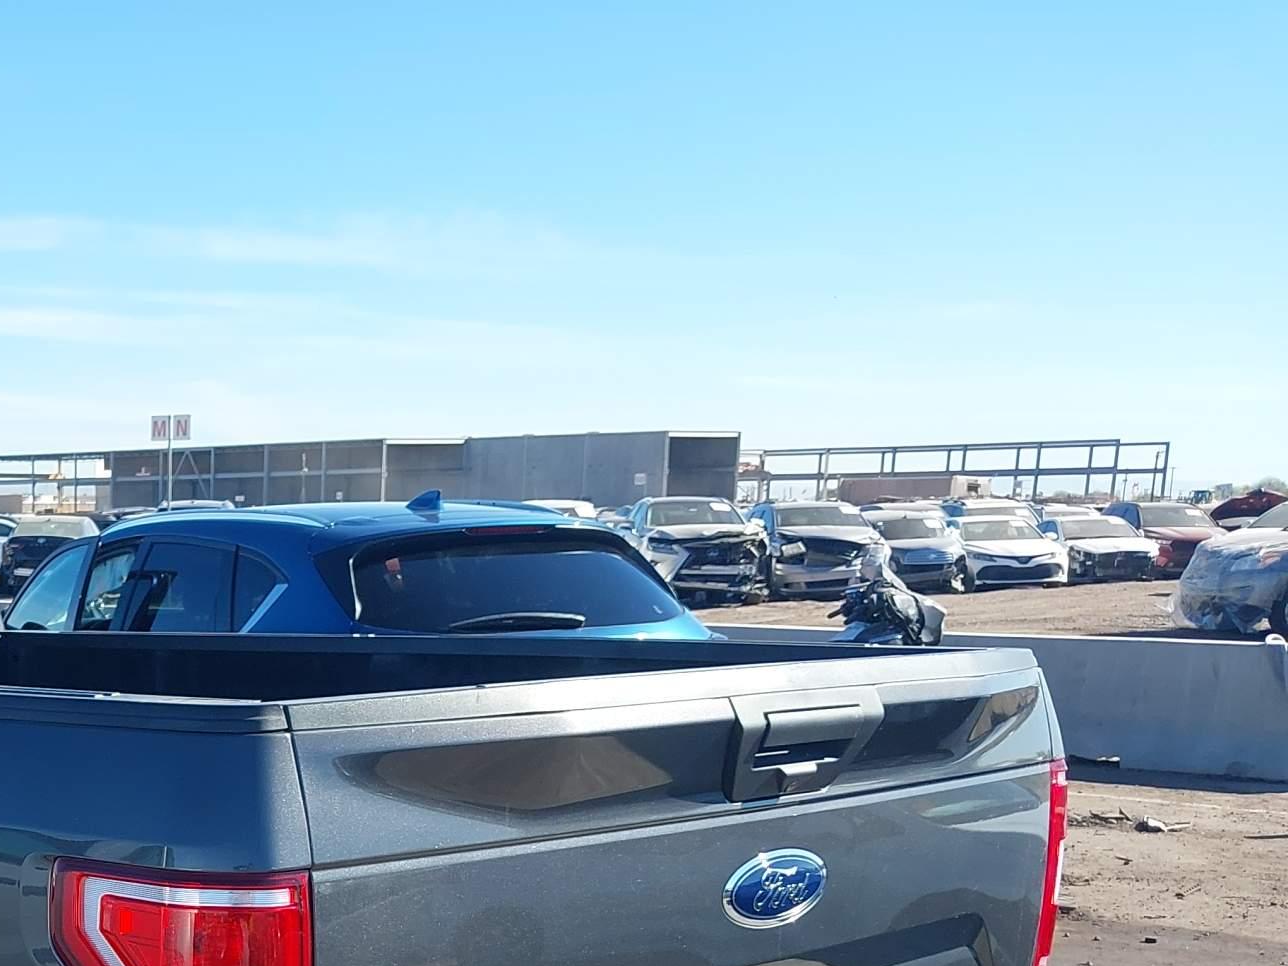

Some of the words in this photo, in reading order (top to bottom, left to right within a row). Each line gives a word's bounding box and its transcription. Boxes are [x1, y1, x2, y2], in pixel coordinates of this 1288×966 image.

[153, 420, 167, 437] M
[176, 419, 188, 437] N
[753, 865, 810, 912] Ford
